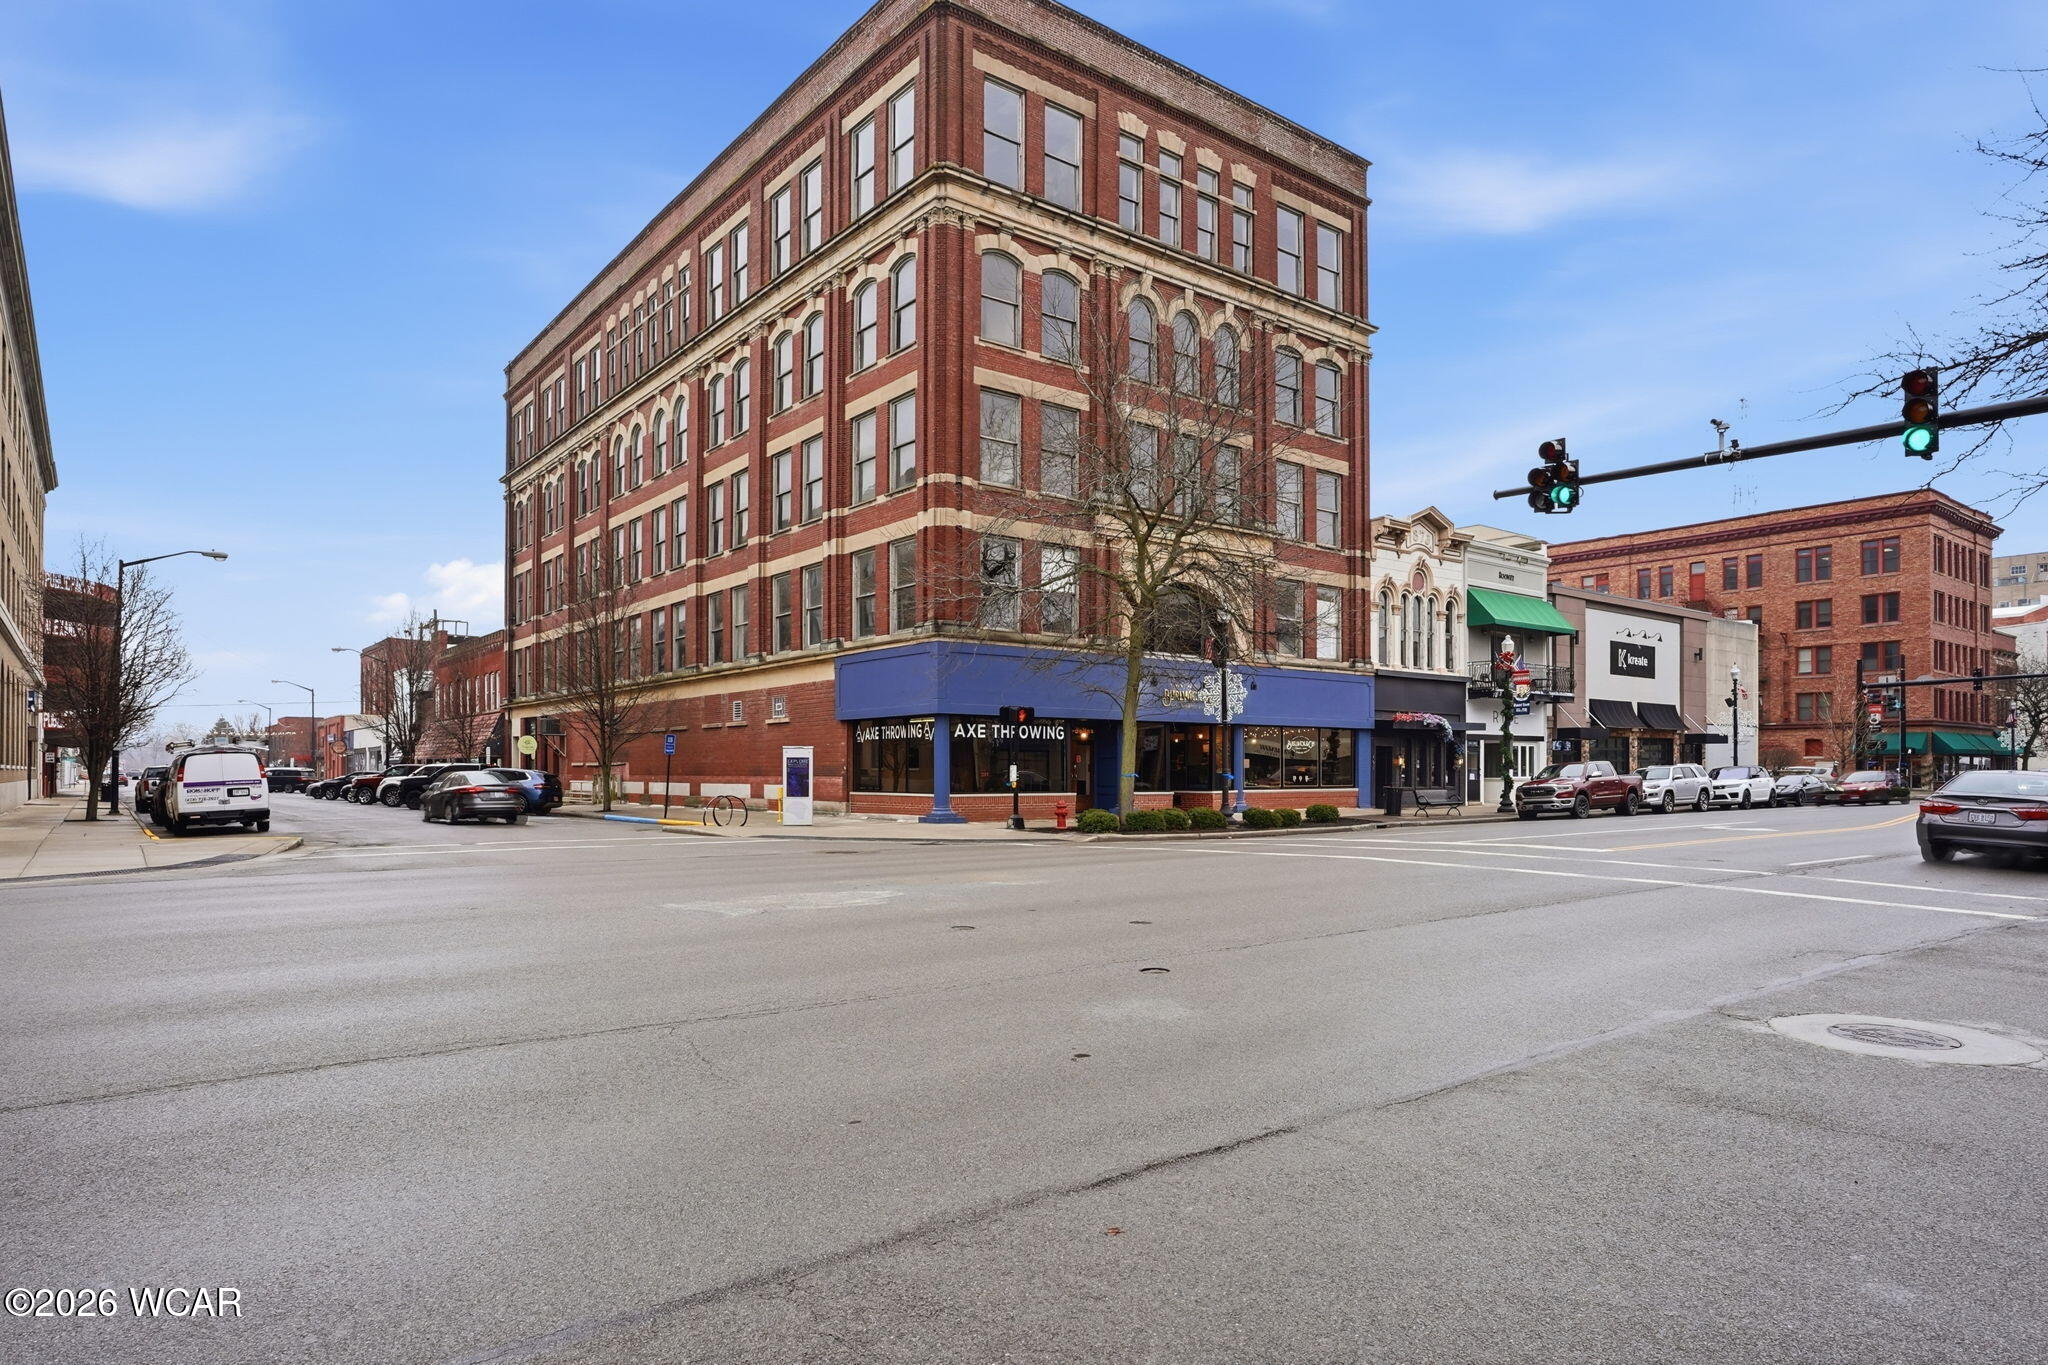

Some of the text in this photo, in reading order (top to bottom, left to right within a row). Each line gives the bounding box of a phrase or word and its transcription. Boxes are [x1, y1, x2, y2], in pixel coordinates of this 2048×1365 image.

[1627, 653, 1649, 667] kreate
[865, 726, 880, 740] AXE
[881, 723, 923, 740] THROWING
[954, 723, 986, 738] AXE
